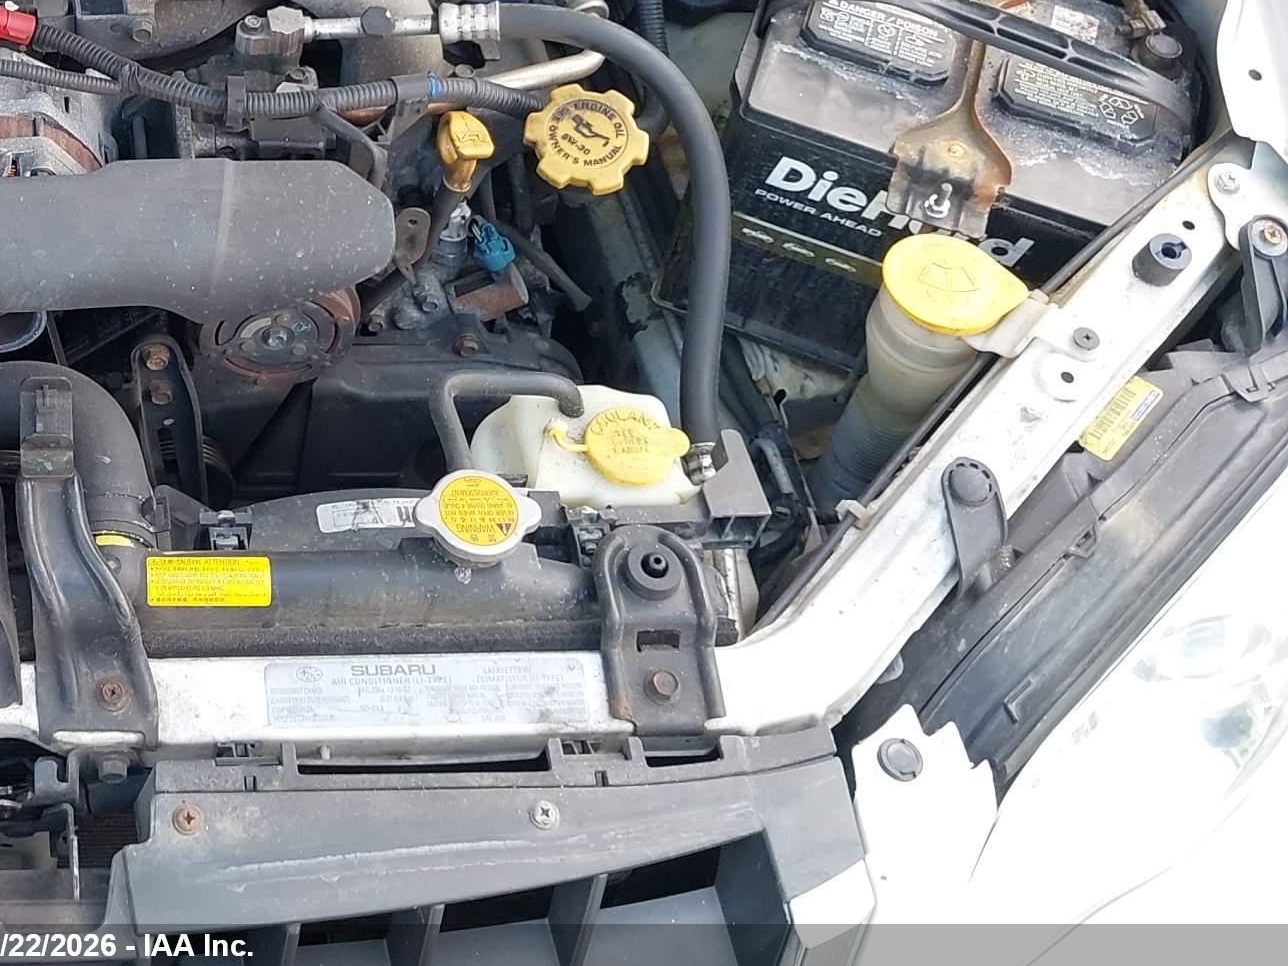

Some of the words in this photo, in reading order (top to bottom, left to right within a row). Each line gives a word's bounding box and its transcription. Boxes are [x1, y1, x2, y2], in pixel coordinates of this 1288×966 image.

[838, 0, 885, 21] DANGER
[896, 18, 939, 37] POISON
[573, 101, 617, 122] ENGINE
[613, 121, 626, 140] OIL
[548, 124, 580, 165] OWNER'S
[583, 145, 623, 167] MANUAL
[755, 188, 815, 215] POWER
[820, 213, 883, 237] AHEAD
[590, 410, 661, 436] COOLANT
[455, 523, 496, 533] WARNING
[331, 677, 347, 686] AIR
[349, 676, 411, 686] CONDITIONER
[351, 664, 436, 677] SUBARU
